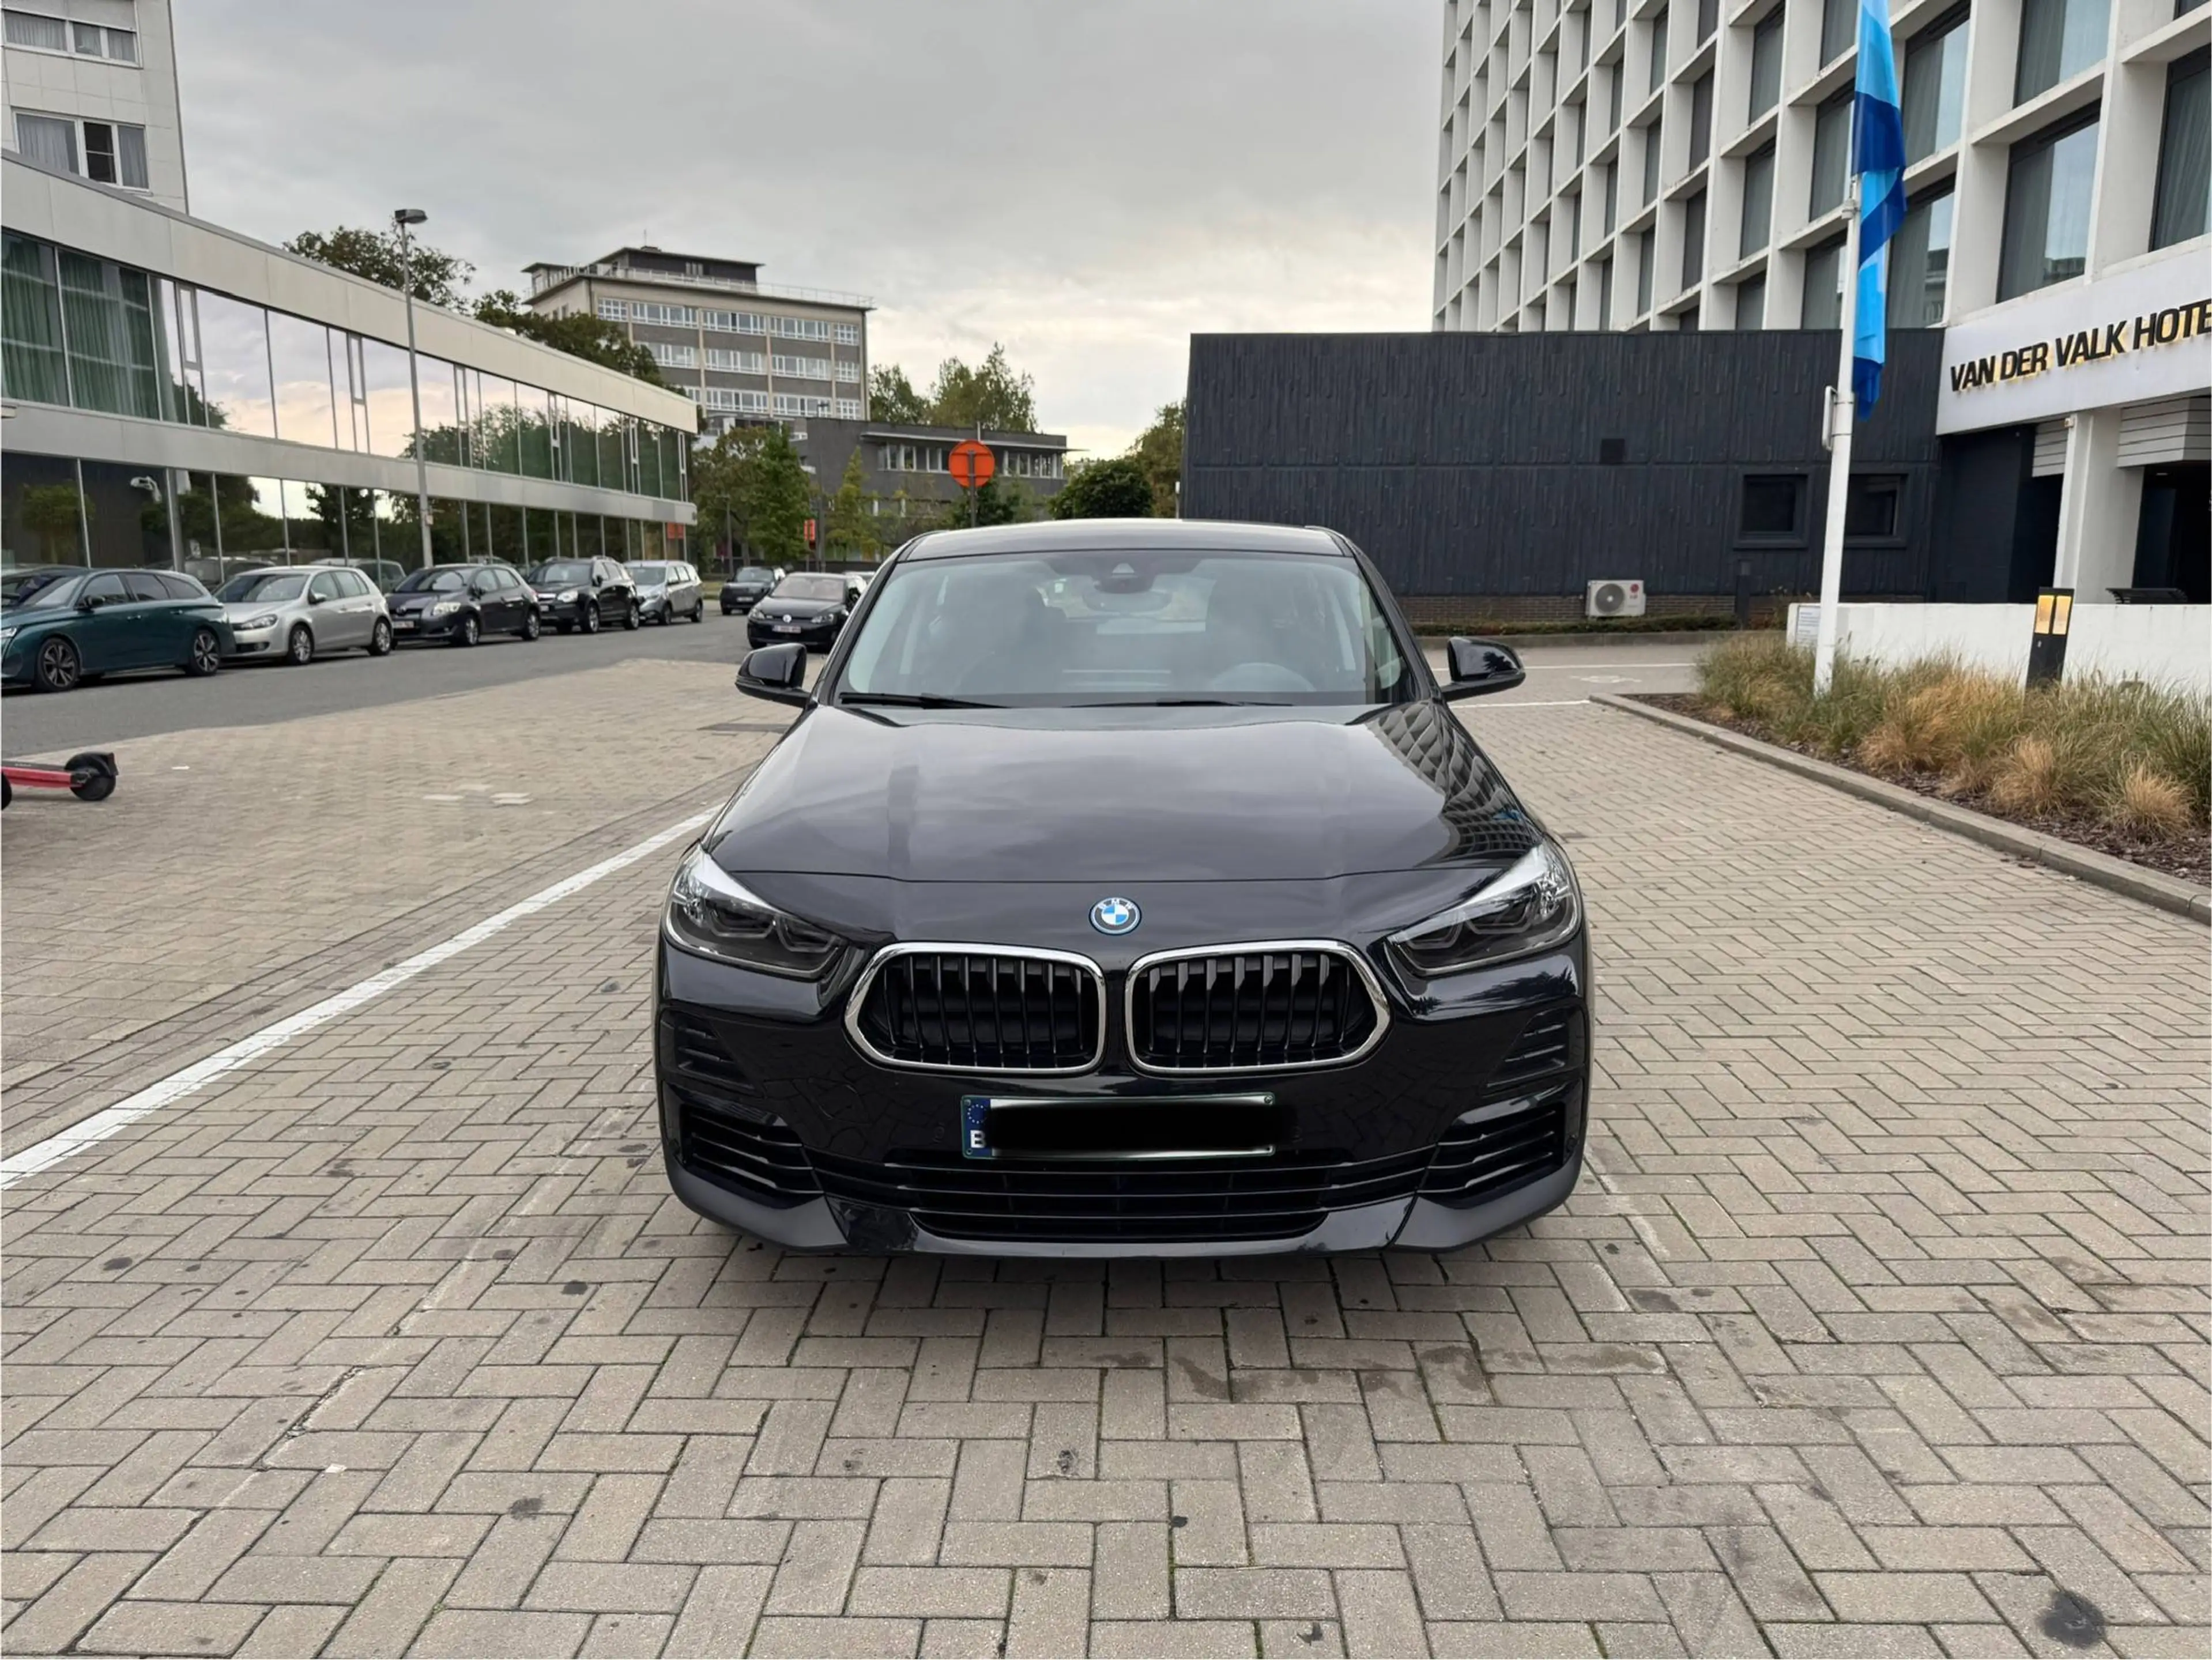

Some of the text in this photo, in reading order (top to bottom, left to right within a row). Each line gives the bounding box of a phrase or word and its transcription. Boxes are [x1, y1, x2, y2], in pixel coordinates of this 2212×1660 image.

[1950, 355, 1995, 391] VAN
[2000, 341, 2048, 379] DER
[2056, 320, 2127, 367] VALK
[970, 1130, 986, 1148] B
